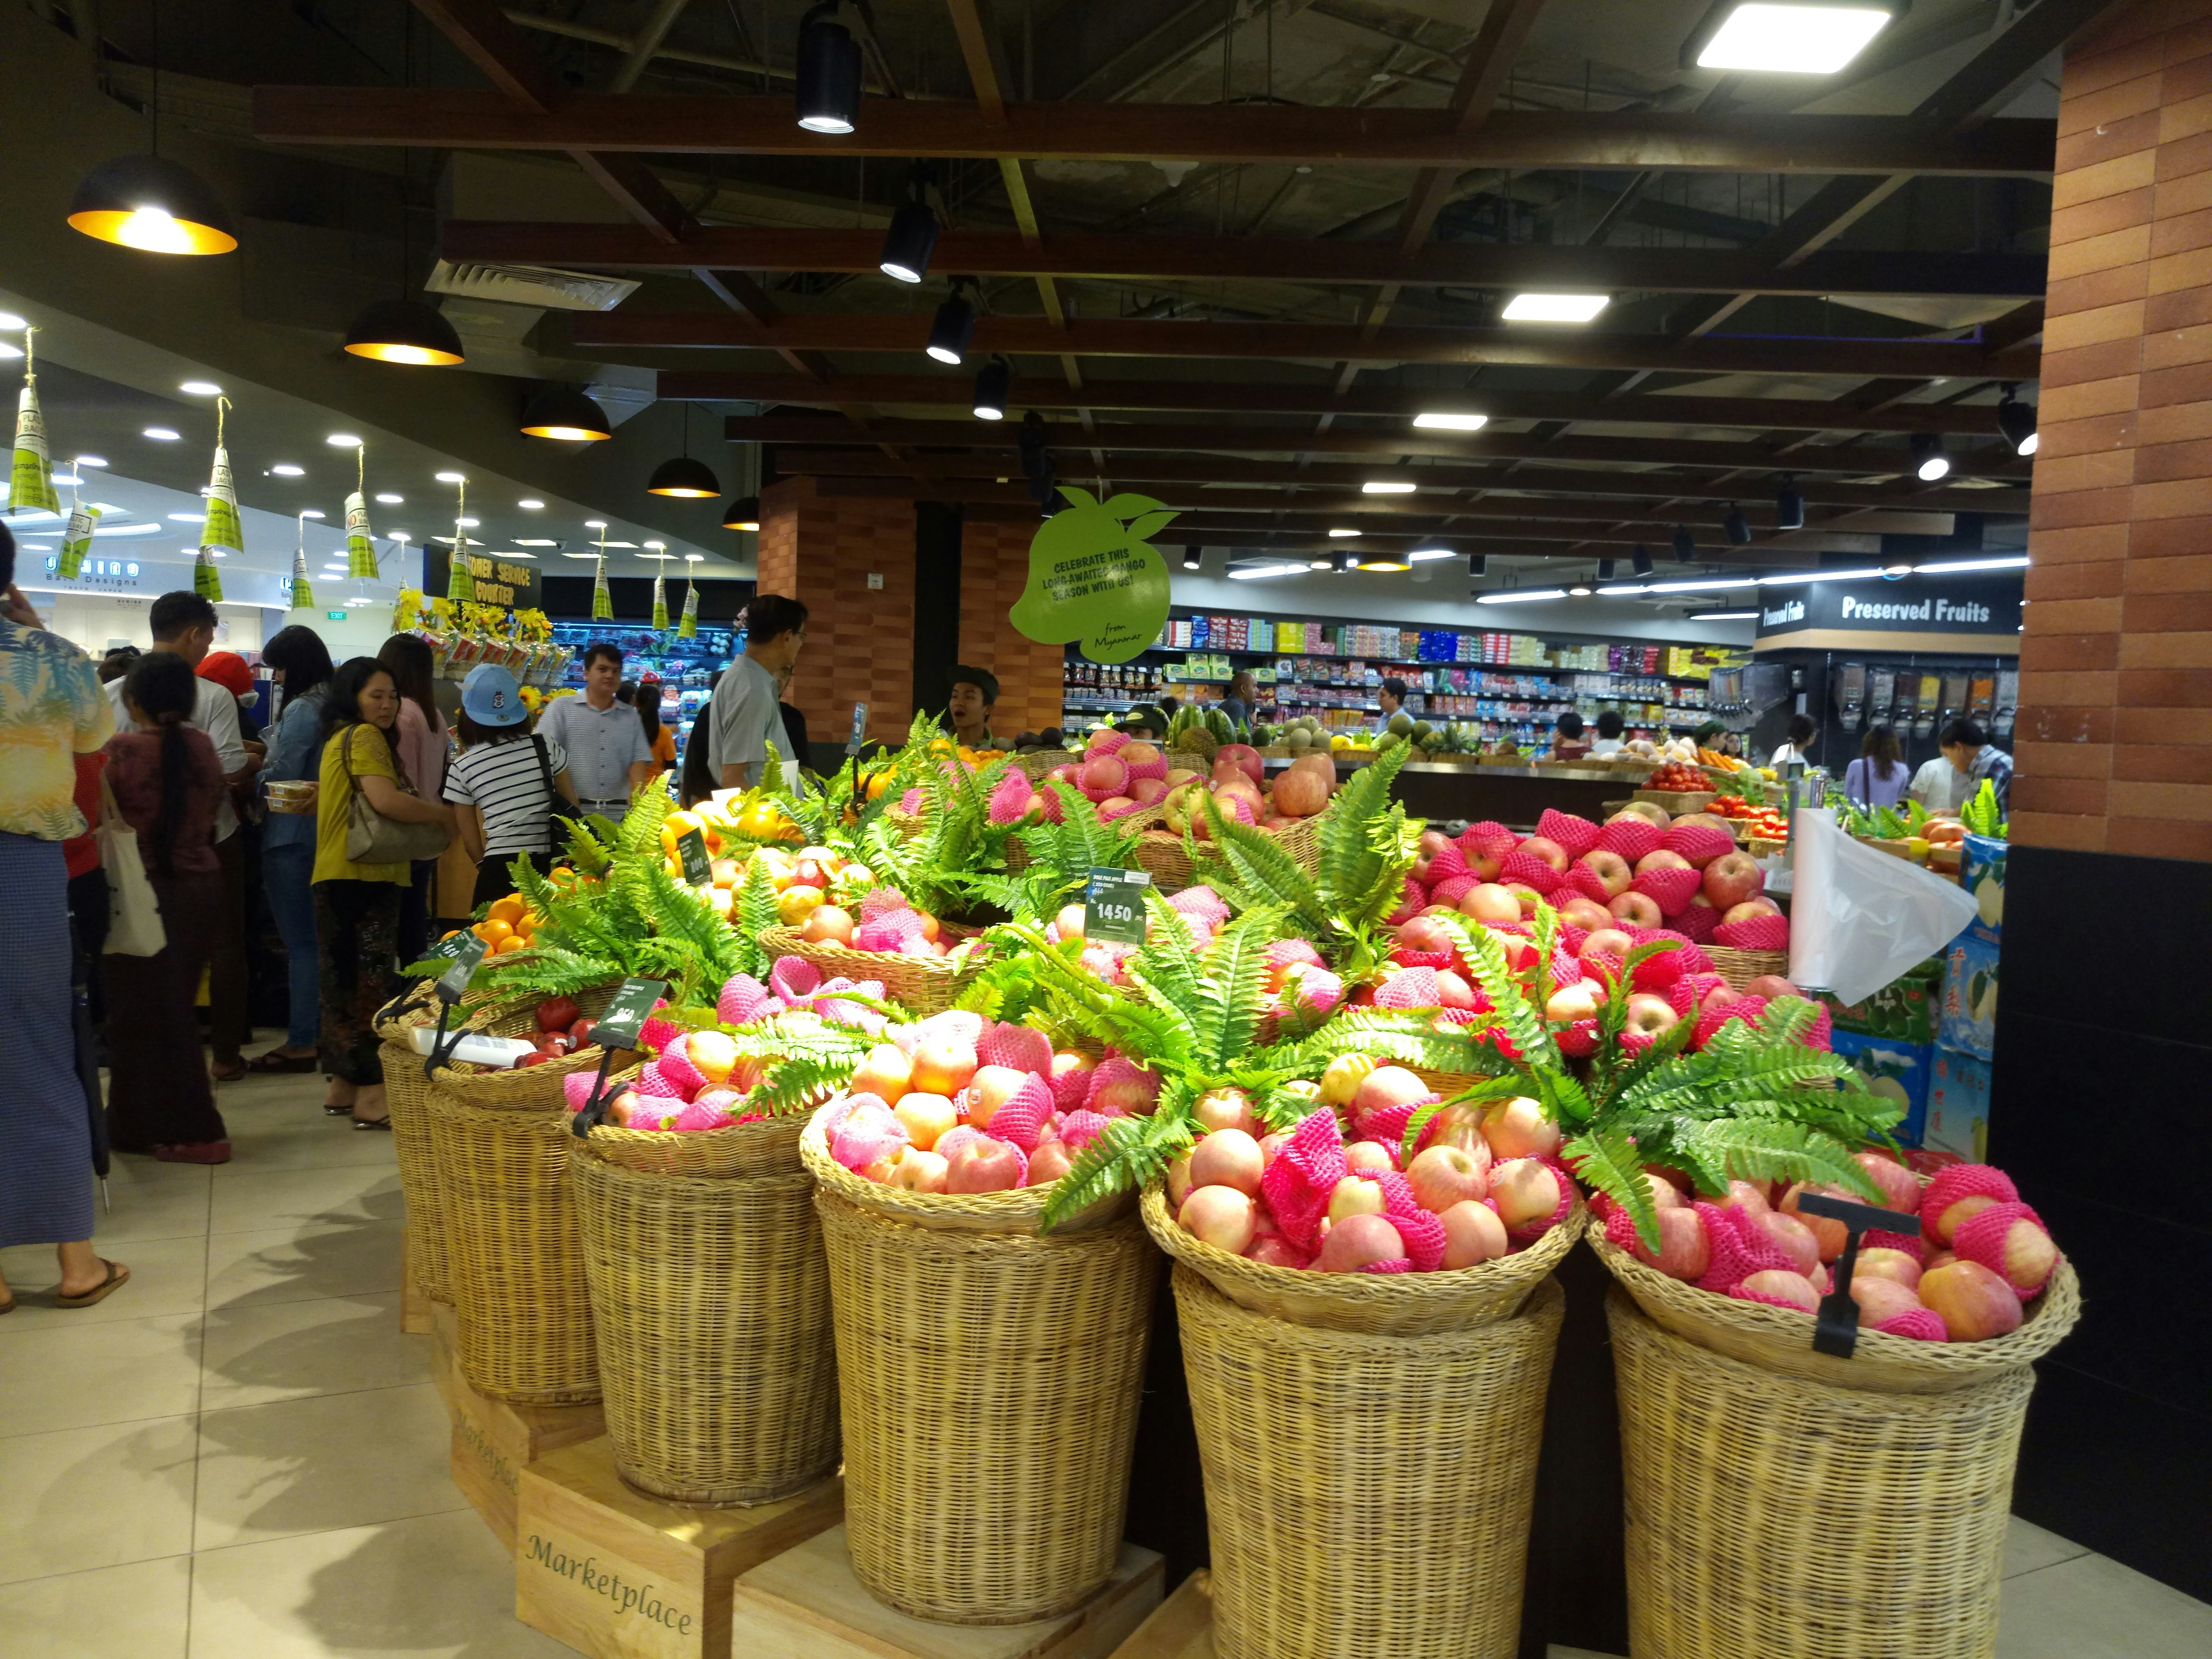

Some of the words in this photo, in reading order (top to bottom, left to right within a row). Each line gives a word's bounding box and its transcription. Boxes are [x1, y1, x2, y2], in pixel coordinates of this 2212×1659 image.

[1054, 553, 1106, 574] CELEBRATE
[1108, 548, 1130, 562] THIS
[85, 576, 137, 587] Designs
[498, 563, 530, 586] SERVICE
[1052, 584, 1089, 601] SEASON
[1091, 579, 1115, 593] WITH
[1117, 574, 1133, 588] US!
[1763, 603, 1787, 627] Preserved
[1788, 599, 1805, 622] Fruits
[1842, 595, 1931, 621] Preserved
[1935, 598, 1990, 623] Fruits
[1105, 622, 1126, 636] from
[1094, 633, 1143, 651] Myanmar
[1097, 903, 1132, 922] 1450
[442, 944, 461, 957] 450
[525, 1535, 692, 1636] Marketplace
